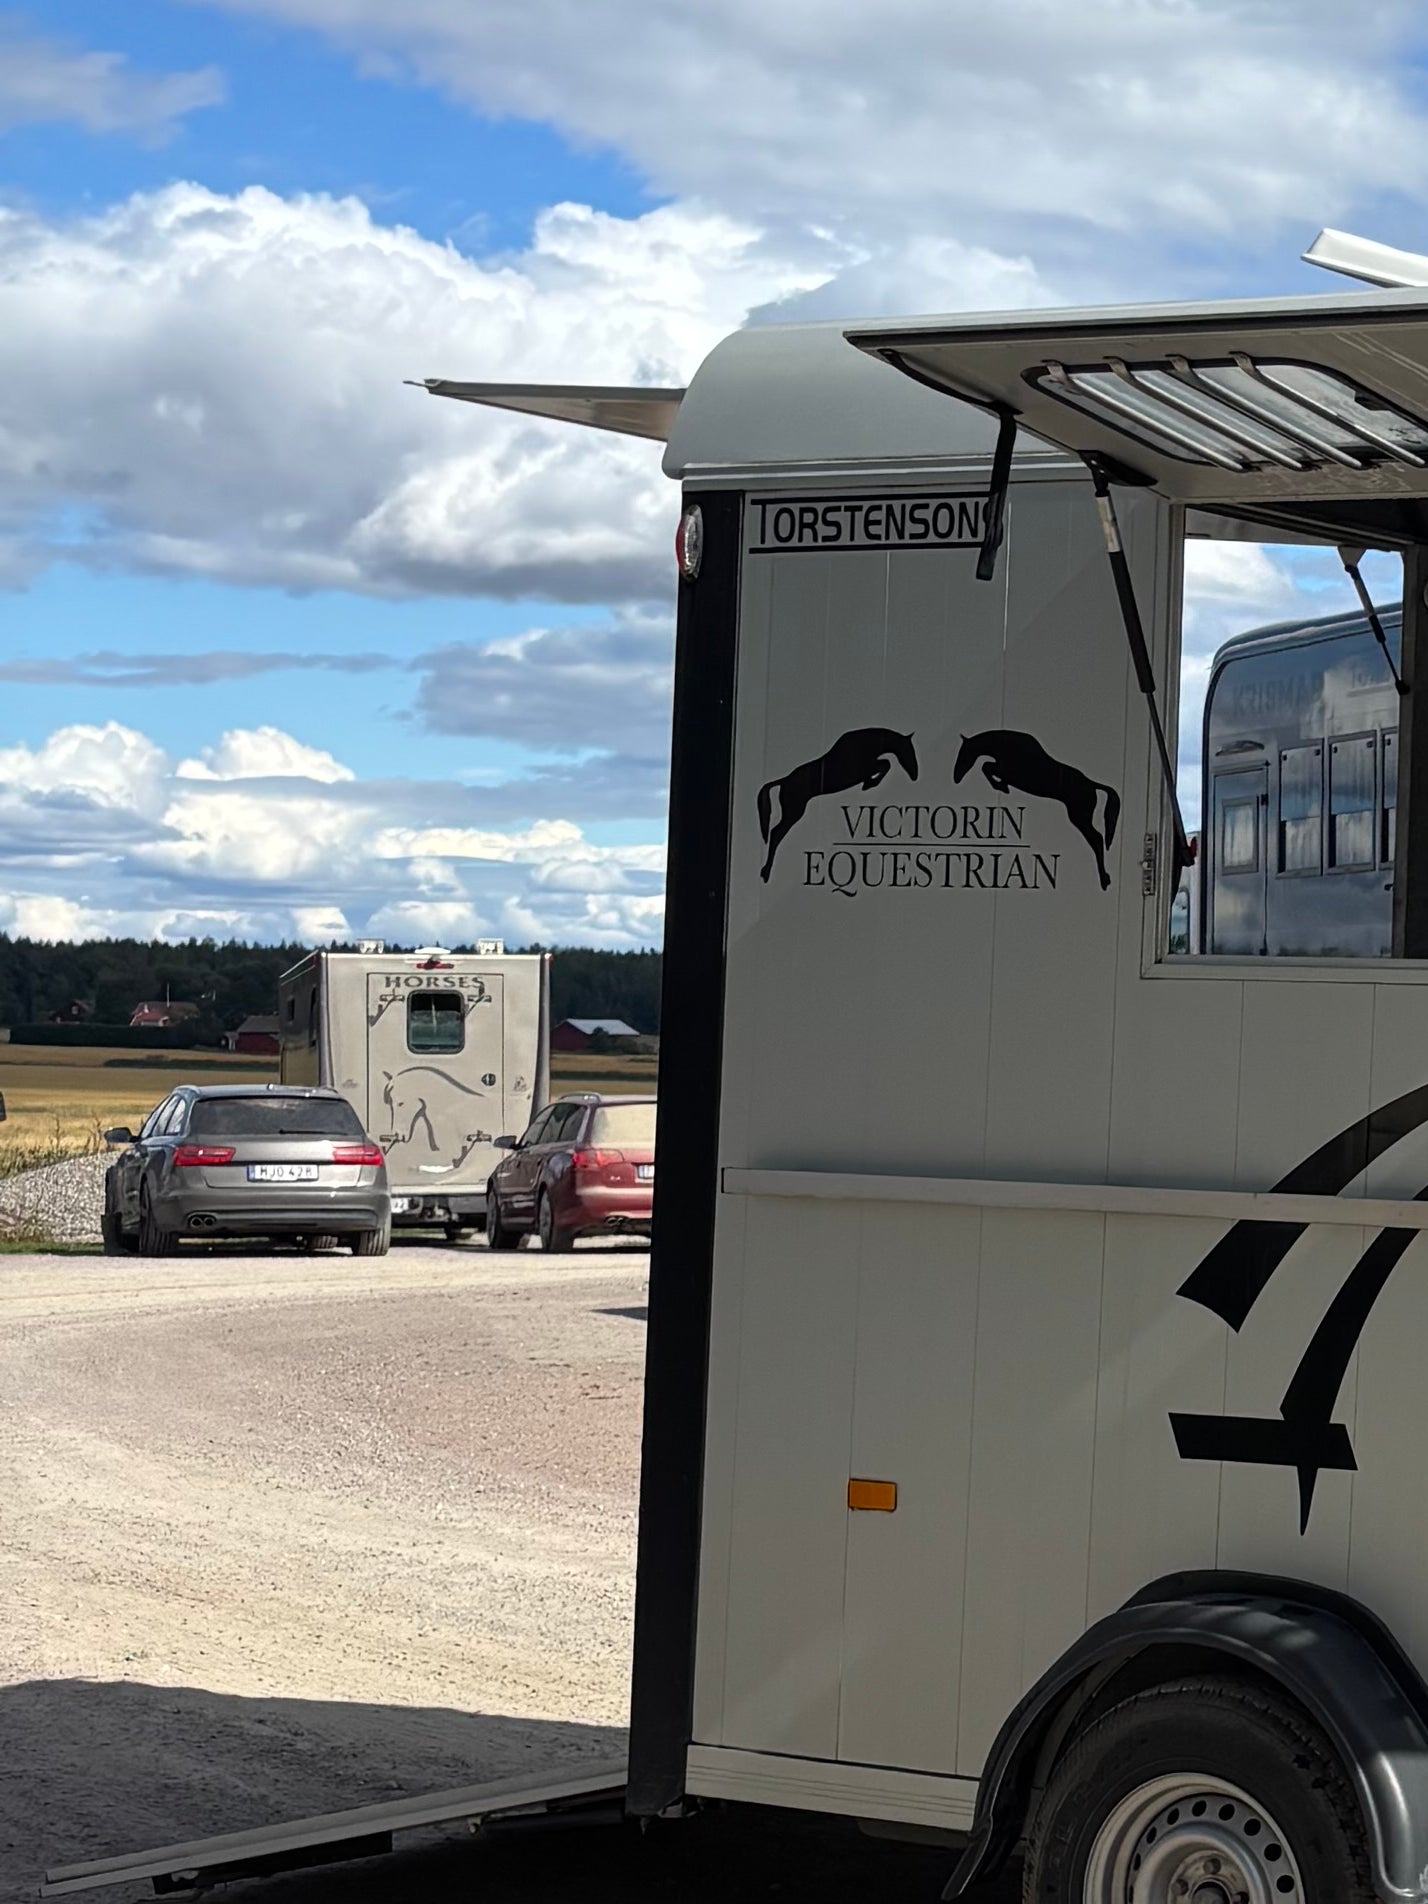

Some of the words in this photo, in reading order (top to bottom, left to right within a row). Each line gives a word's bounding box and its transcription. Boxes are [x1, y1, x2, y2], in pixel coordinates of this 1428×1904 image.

[841, 804, 1027, 840] VICTORIN
[802, 851, 1061, 897] EQUESTRIAN
[385, 976, 485, 989] HORSES
